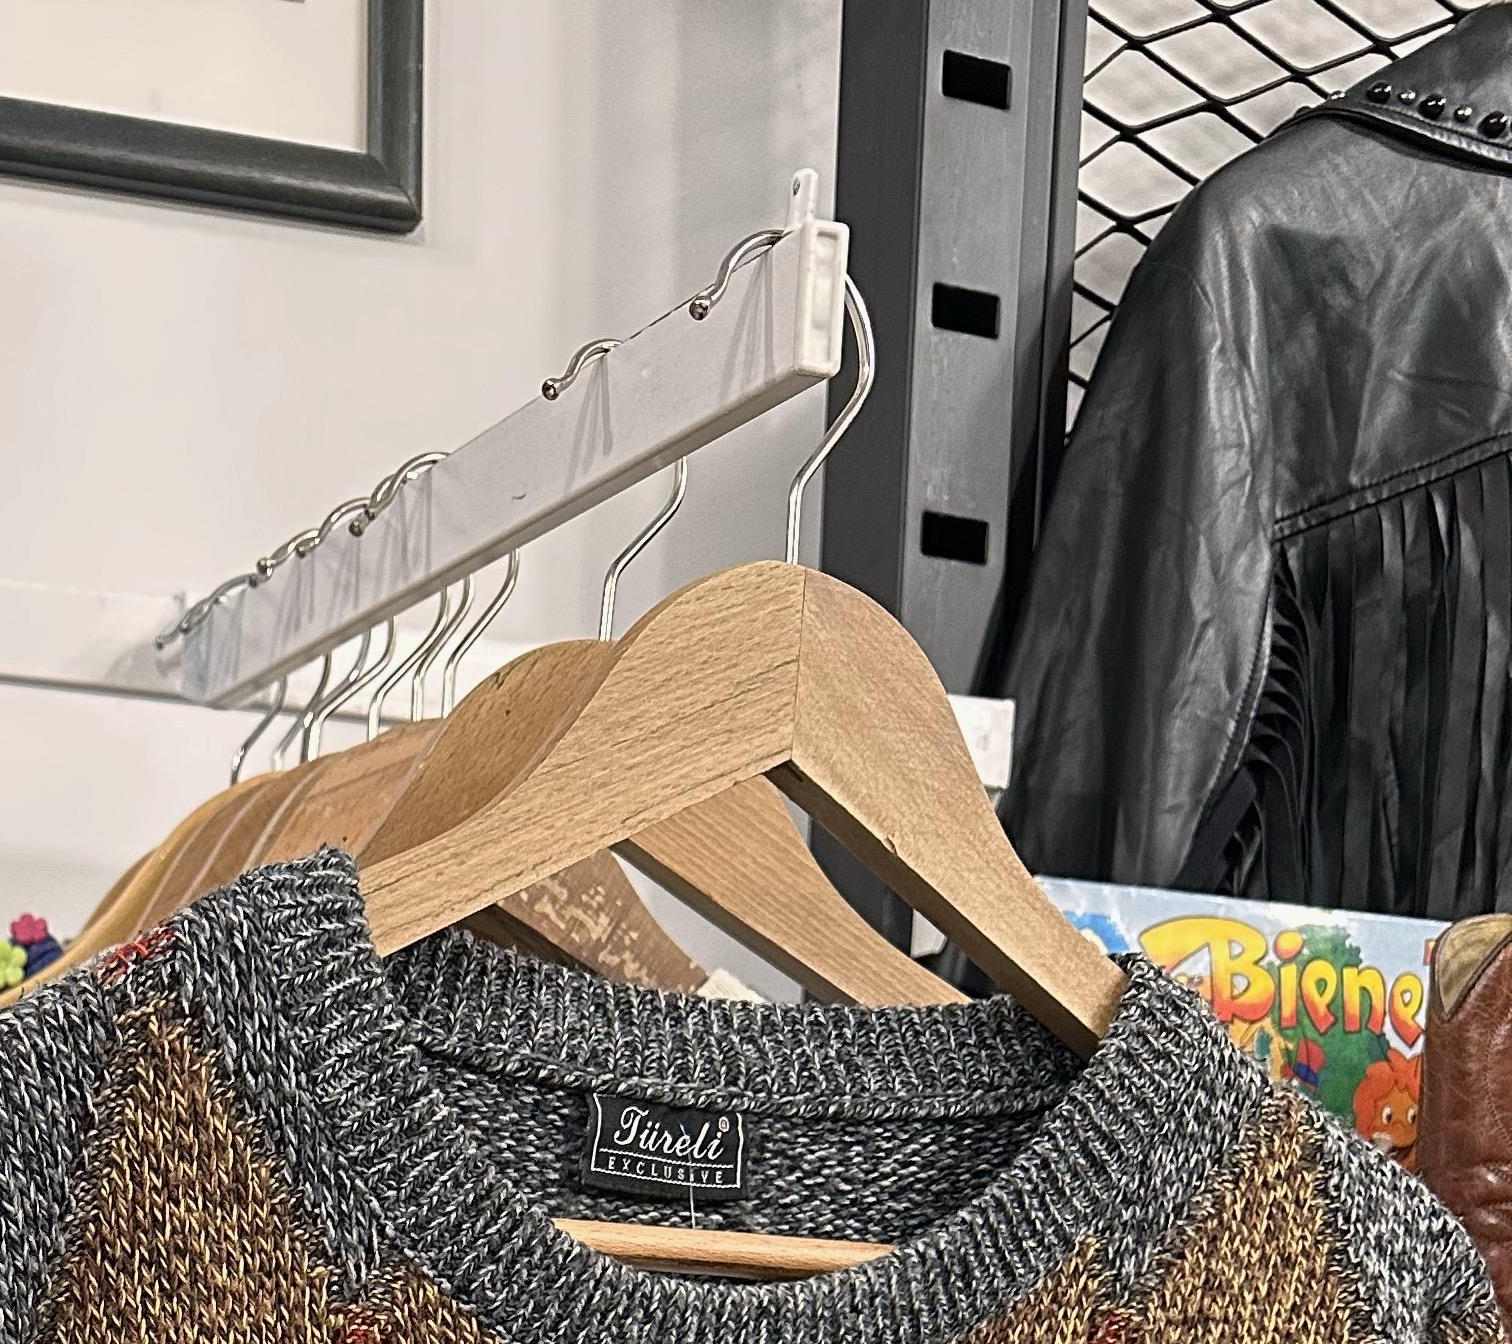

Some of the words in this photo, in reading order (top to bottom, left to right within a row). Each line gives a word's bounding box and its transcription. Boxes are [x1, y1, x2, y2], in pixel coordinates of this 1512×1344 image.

[1139, 914, 1424, 1047] Biene
[613, 1105, 724, 1161] Türeli
[607, 1156, 724, 1184] EXCLUSIVE
